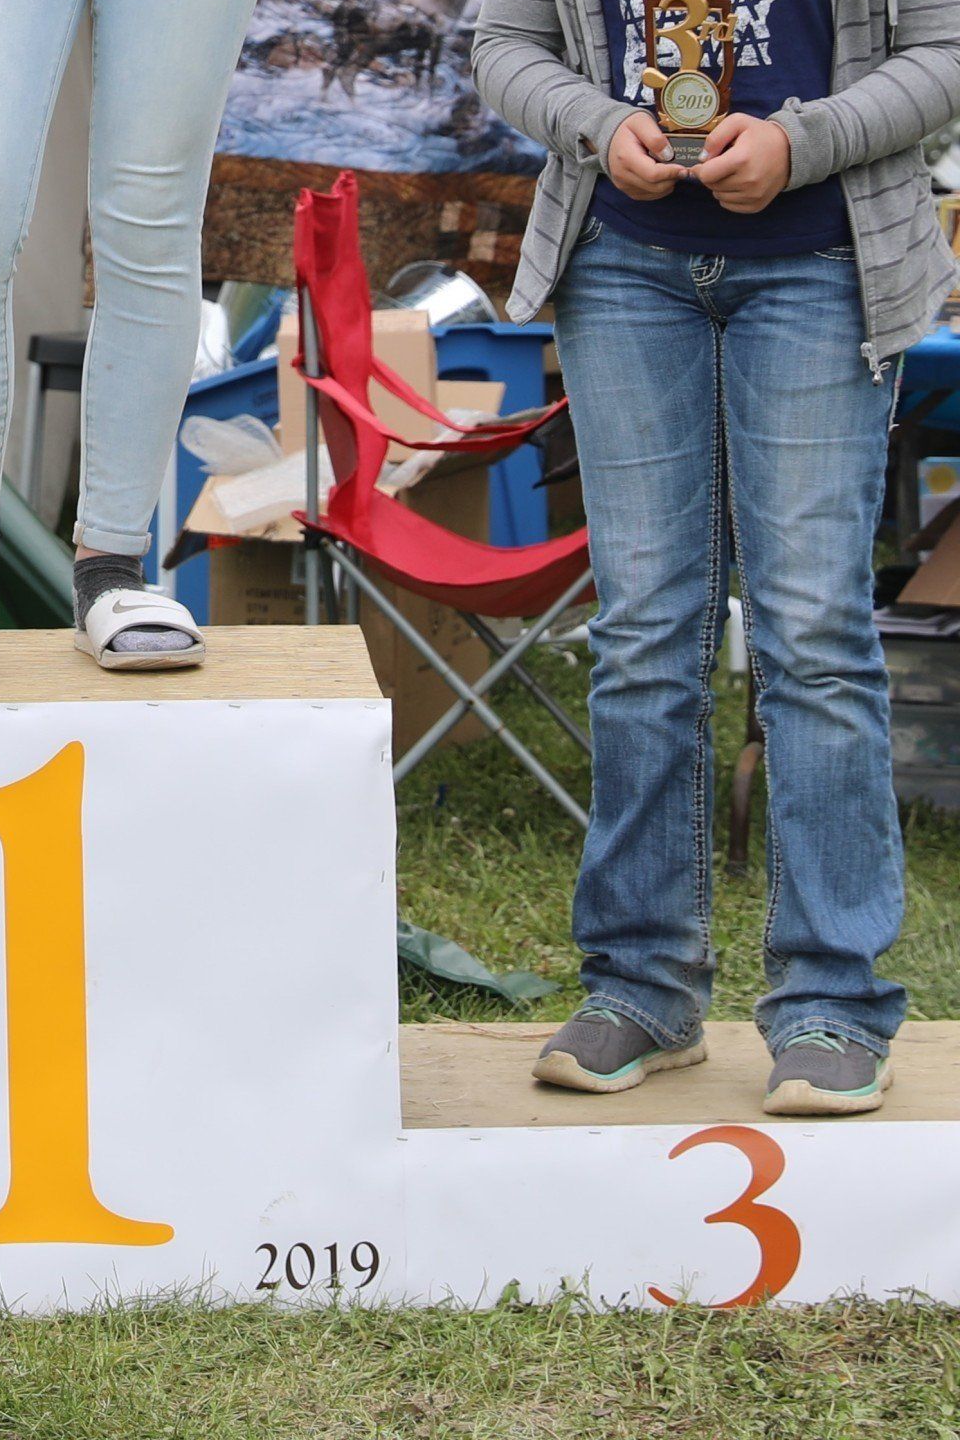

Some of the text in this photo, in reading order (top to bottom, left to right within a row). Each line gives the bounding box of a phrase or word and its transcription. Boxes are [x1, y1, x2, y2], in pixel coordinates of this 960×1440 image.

[676, 94, 713, 110] 2019
[648, 1125, 801, 1309] 3
[254, 1241, 380, 1290] 2019
